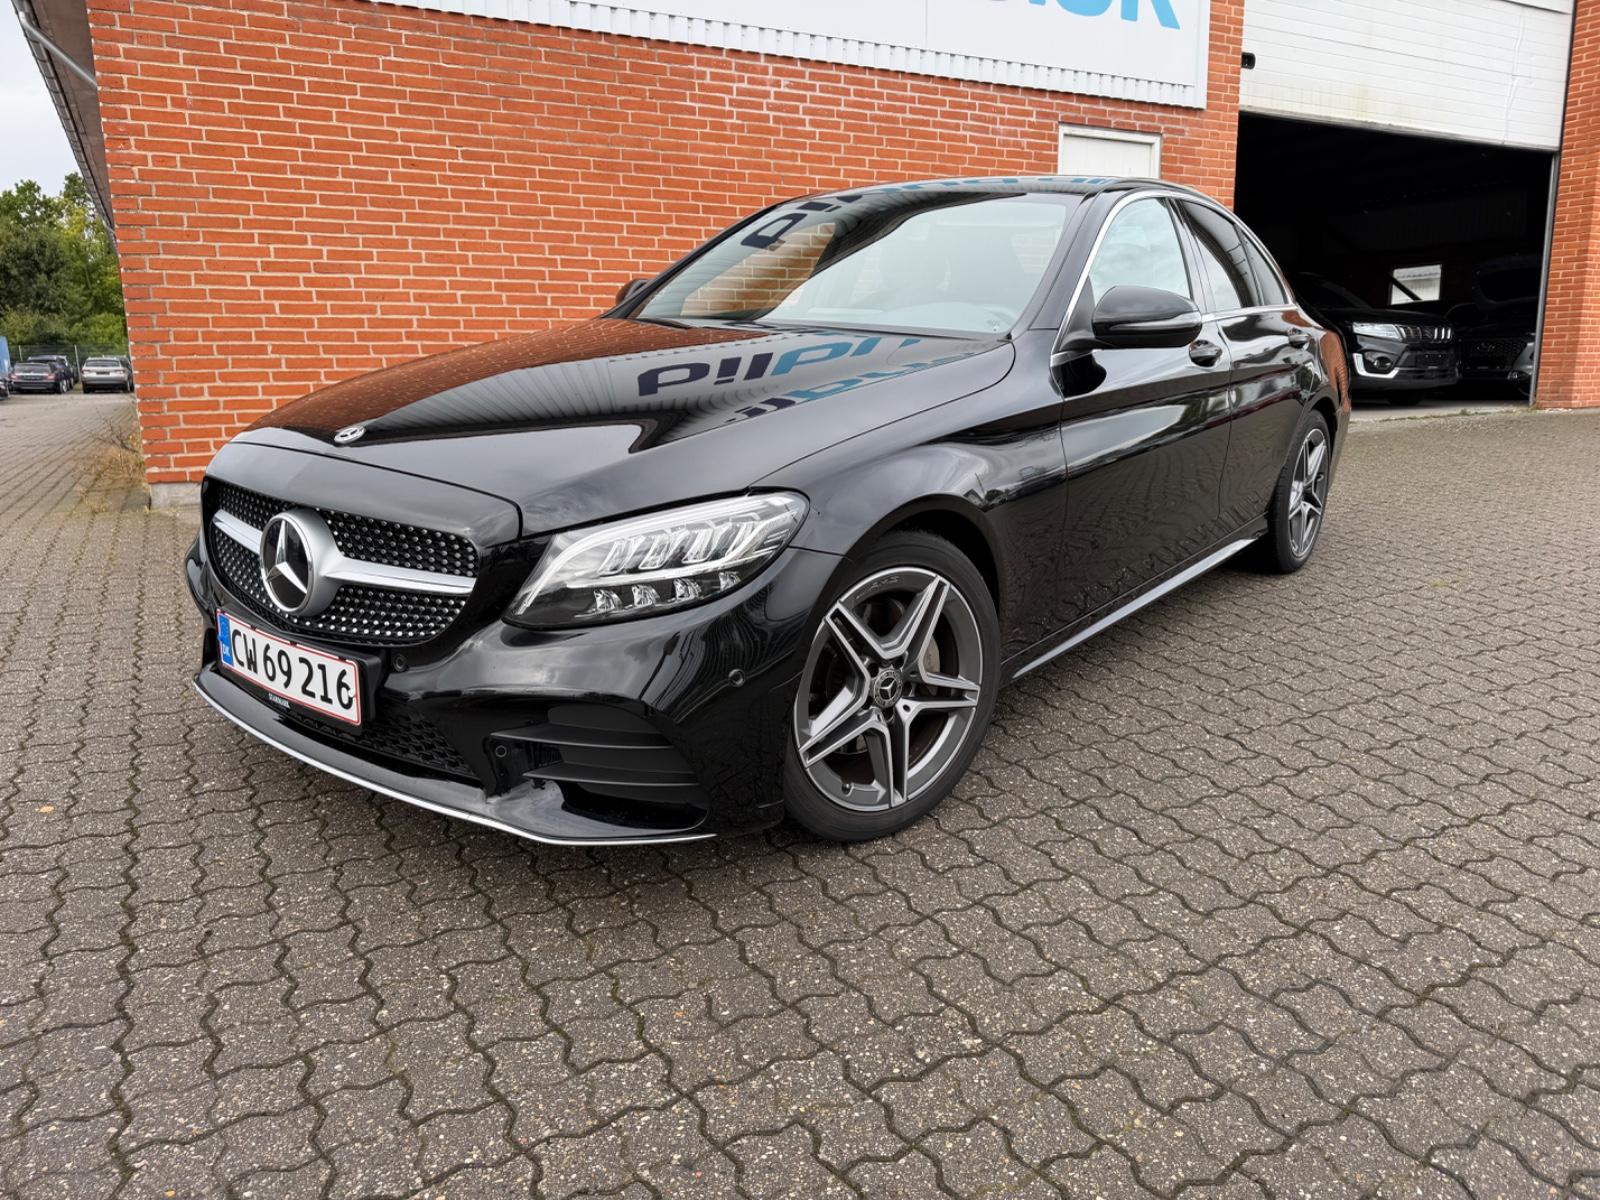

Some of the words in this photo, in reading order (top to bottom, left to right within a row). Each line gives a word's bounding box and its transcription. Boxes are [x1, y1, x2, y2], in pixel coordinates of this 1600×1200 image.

[232, 629, 258, 675] CW
[263, 643, 292, 689] 69
[299, 657, 353, 709] 216
